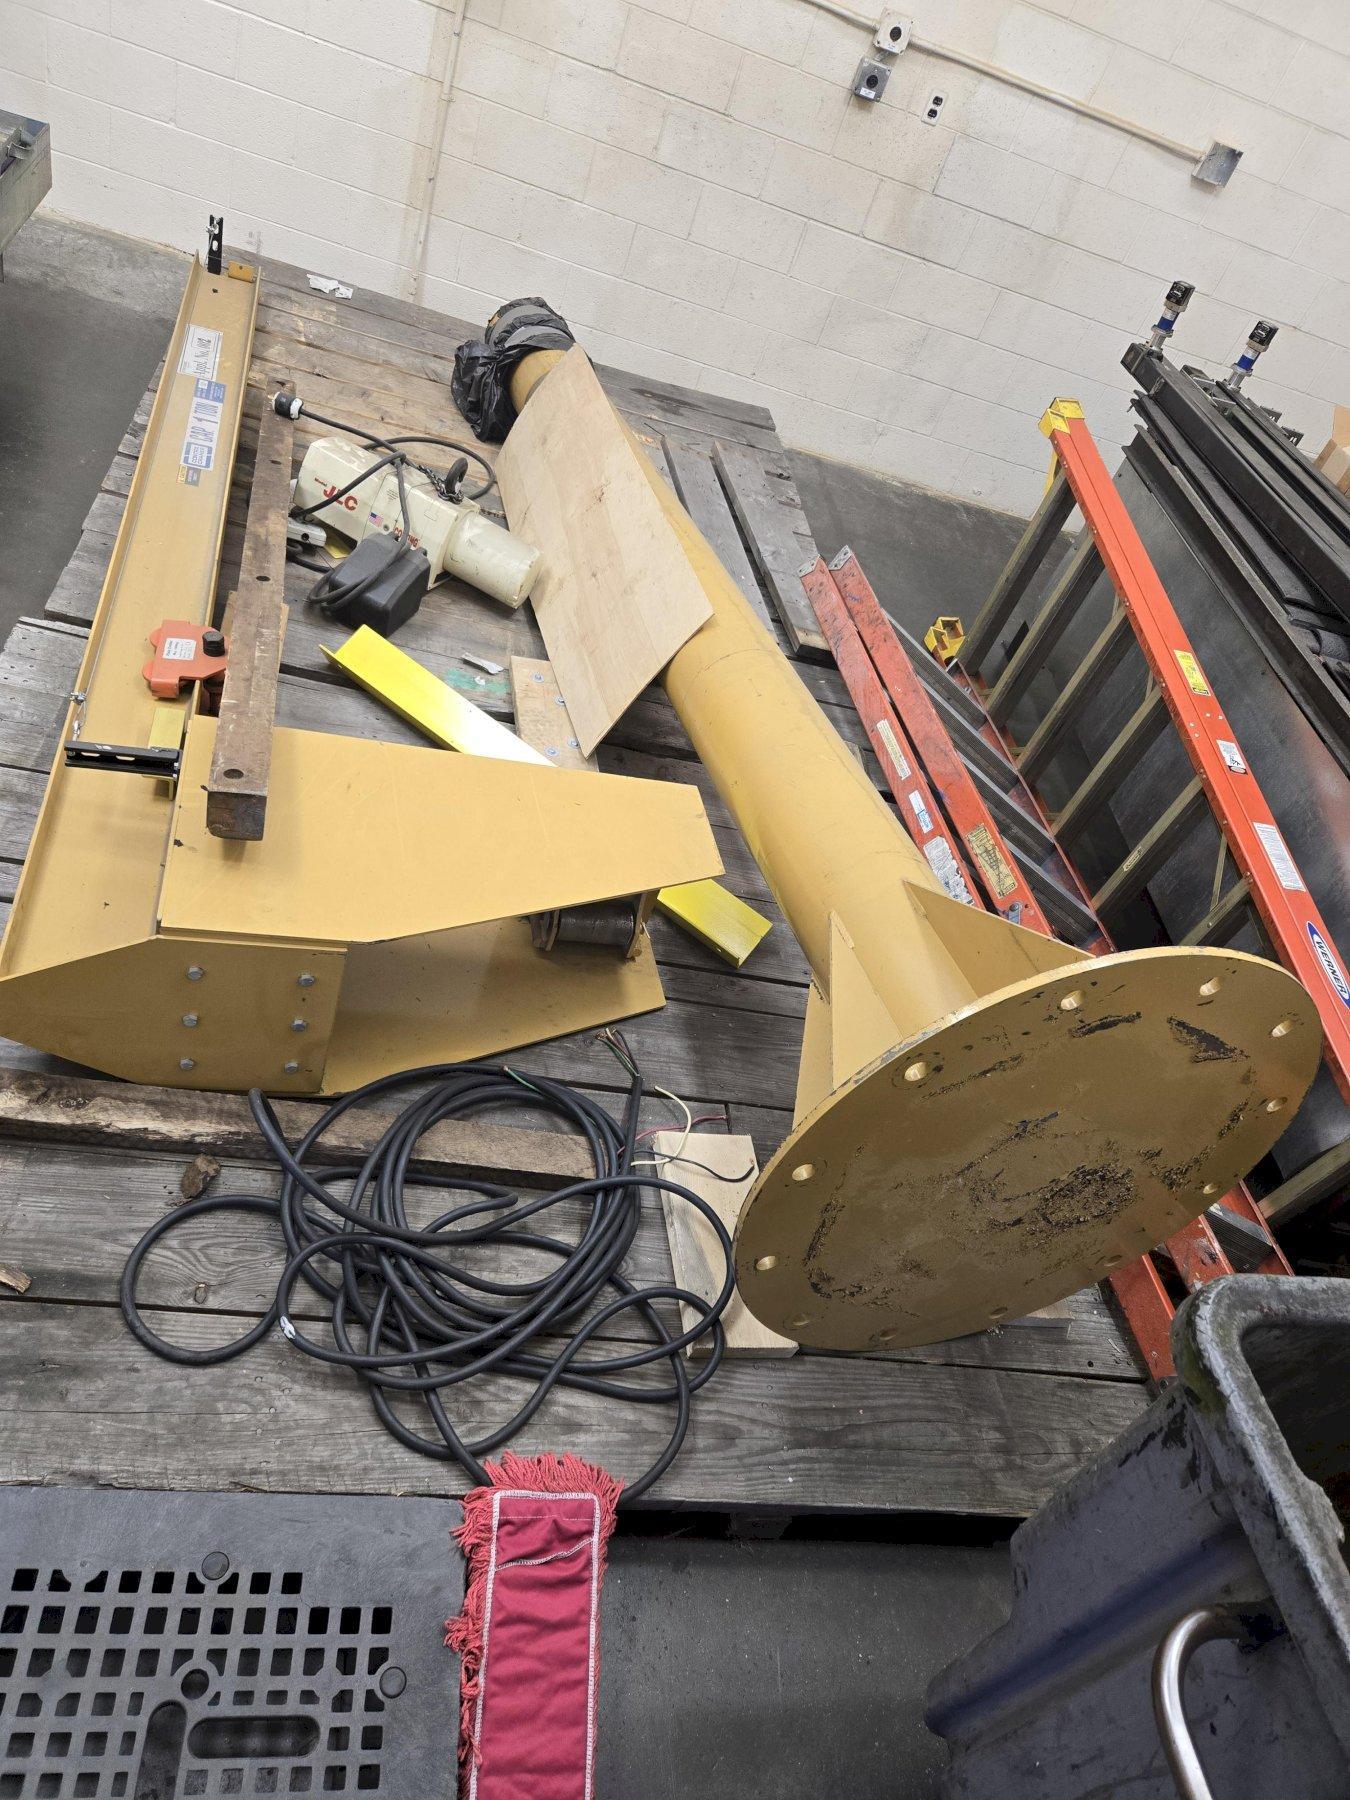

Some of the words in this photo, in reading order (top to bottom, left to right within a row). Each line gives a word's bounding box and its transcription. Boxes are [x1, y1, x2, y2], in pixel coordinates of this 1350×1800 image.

[194, 402, 218, 416] TON
[192, 415, 219, 424] 1
[1315, 940, 1347, 995] WERNER
